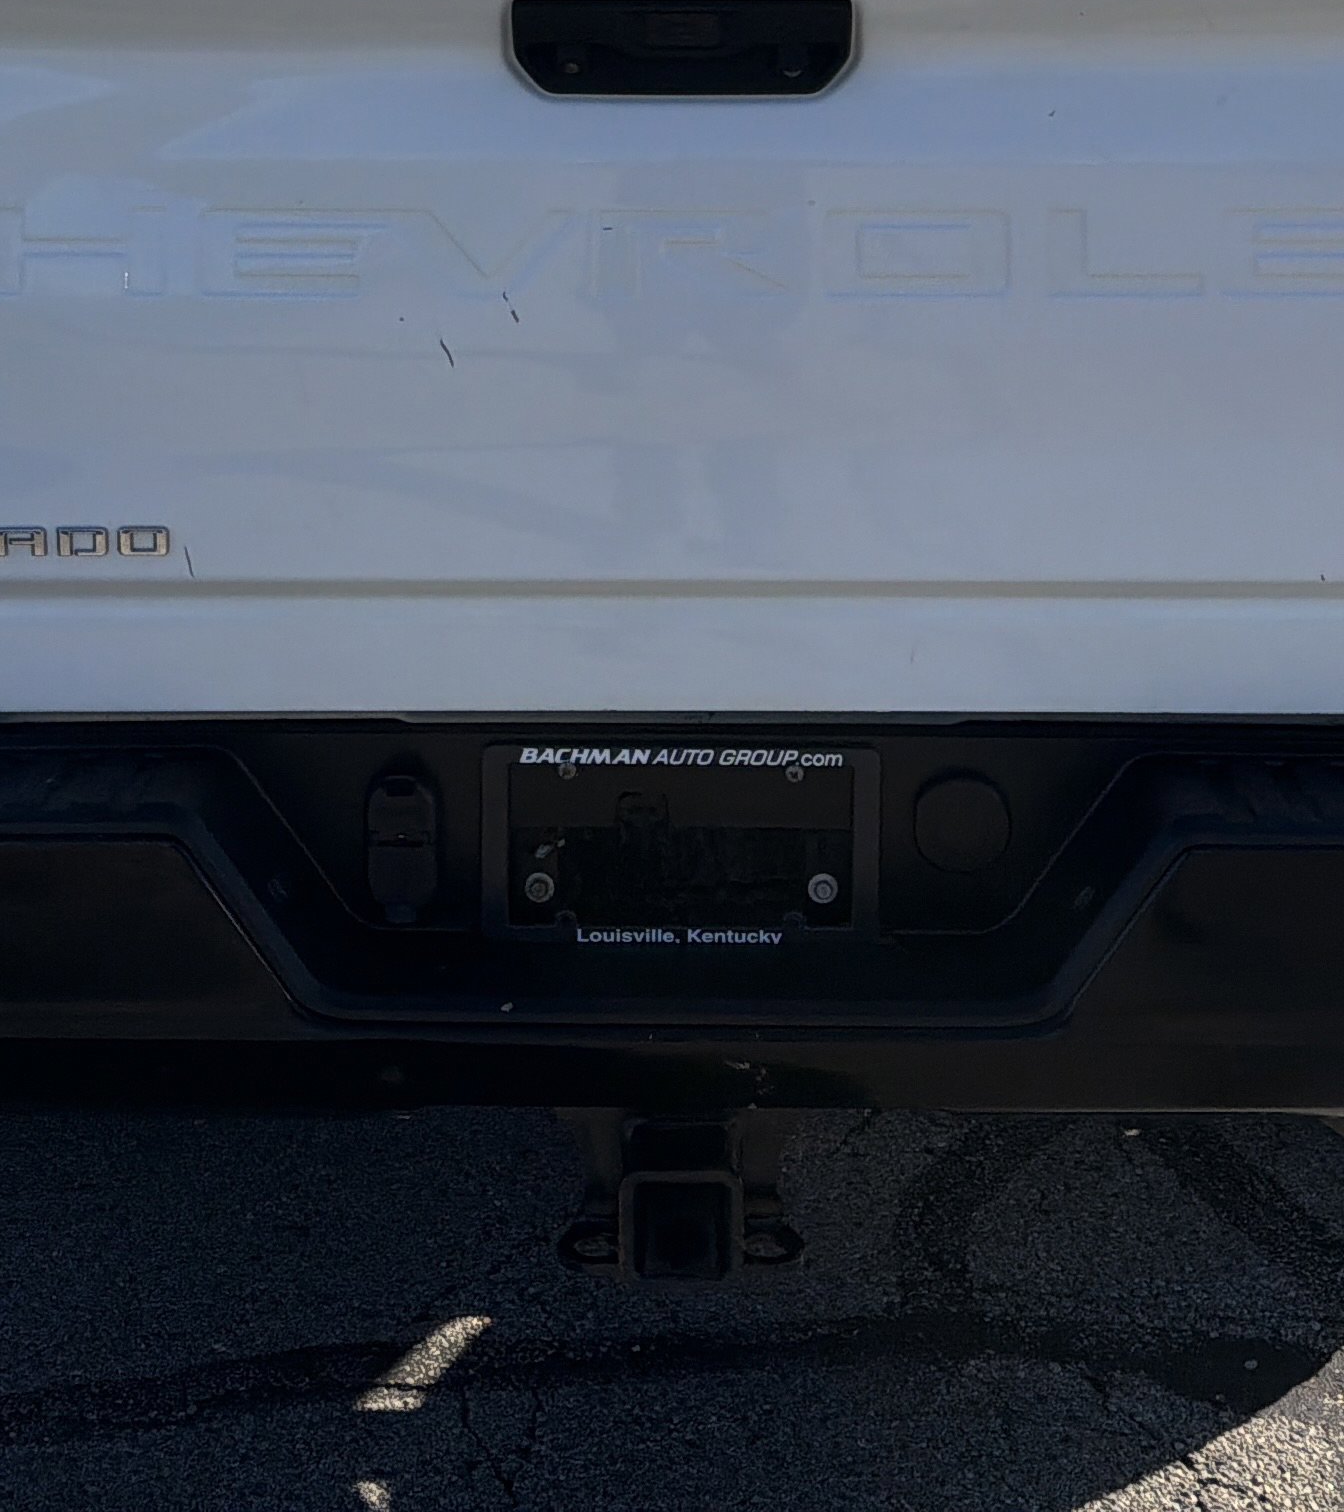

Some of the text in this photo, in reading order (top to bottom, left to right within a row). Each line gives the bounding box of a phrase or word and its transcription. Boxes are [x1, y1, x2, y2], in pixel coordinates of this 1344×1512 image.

[519, 747, 843, 767] BACHMAN AUTO GROUP.com
[687, 928, 783, 945] Kentucky
